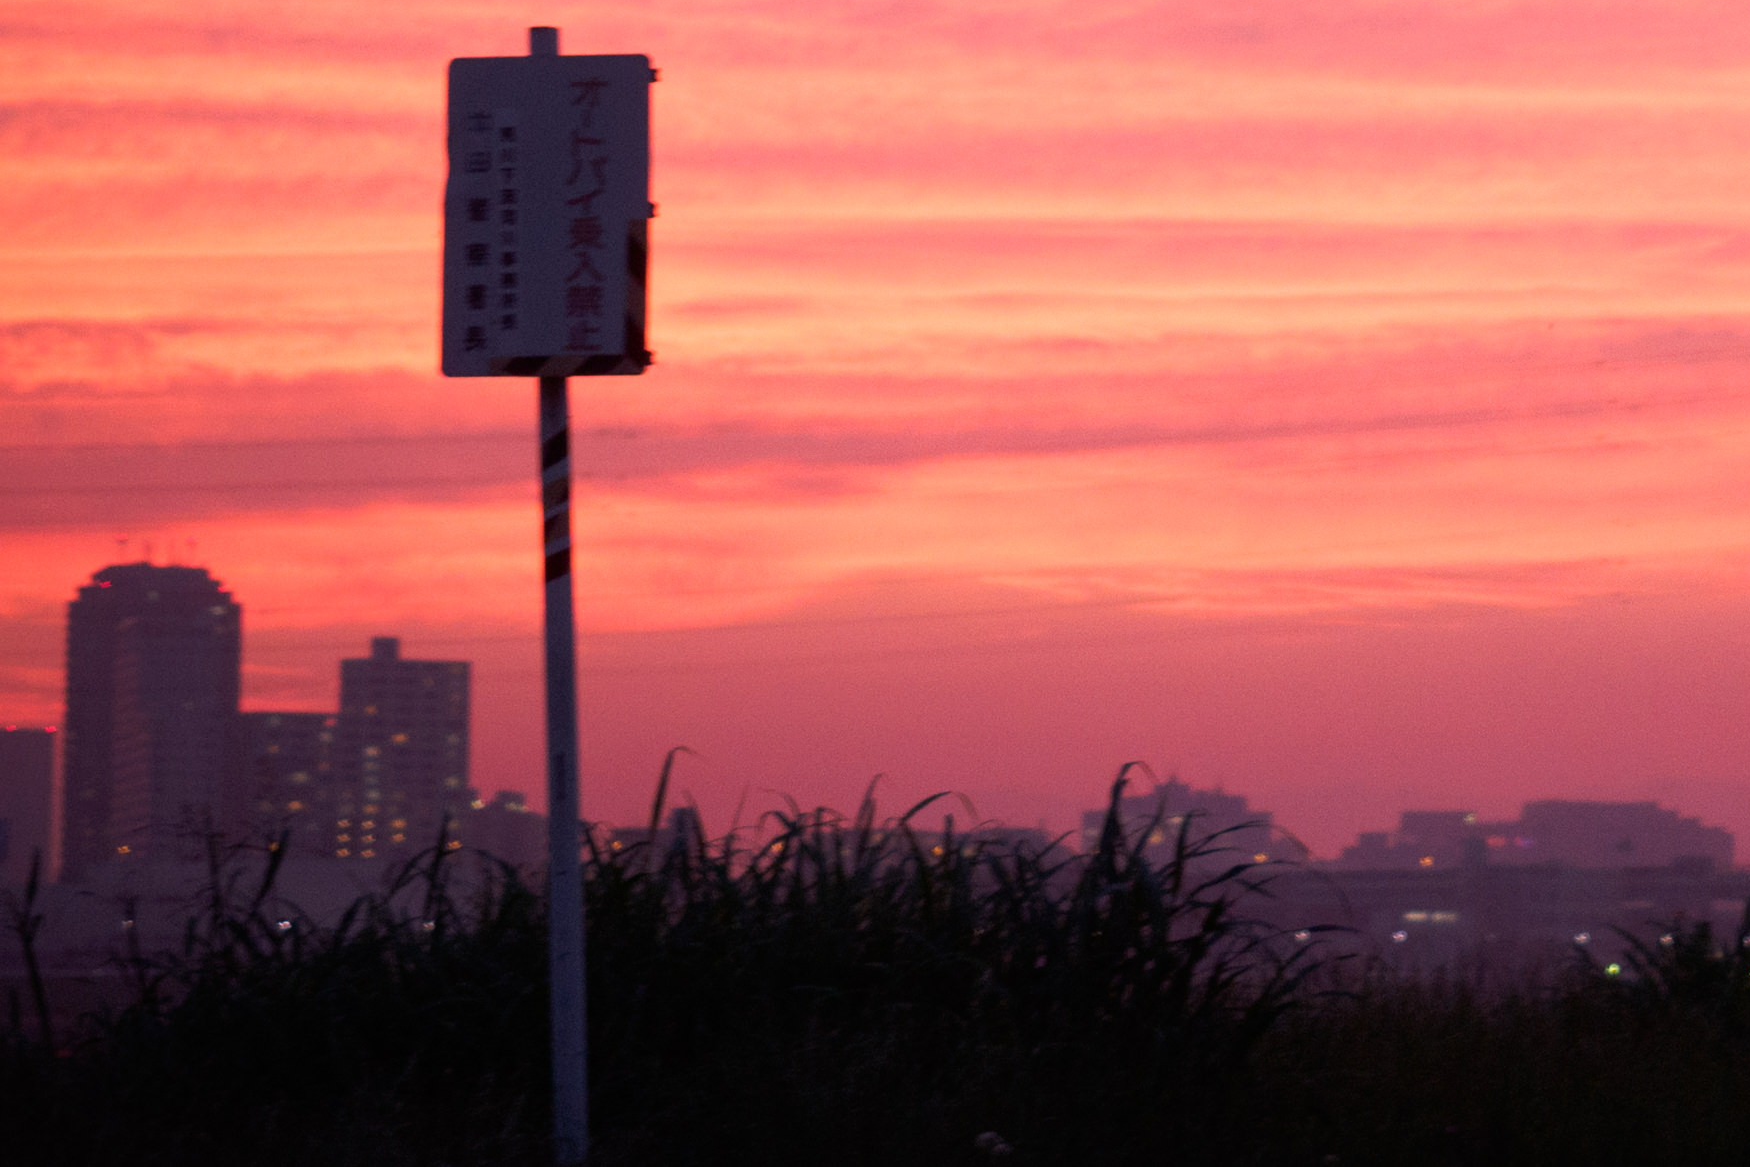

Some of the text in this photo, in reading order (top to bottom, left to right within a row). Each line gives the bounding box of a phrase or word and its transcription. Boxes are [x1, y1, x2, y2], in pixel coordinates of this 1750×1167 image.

[563, 77, 608, 351] オートバイ乗入禁止
